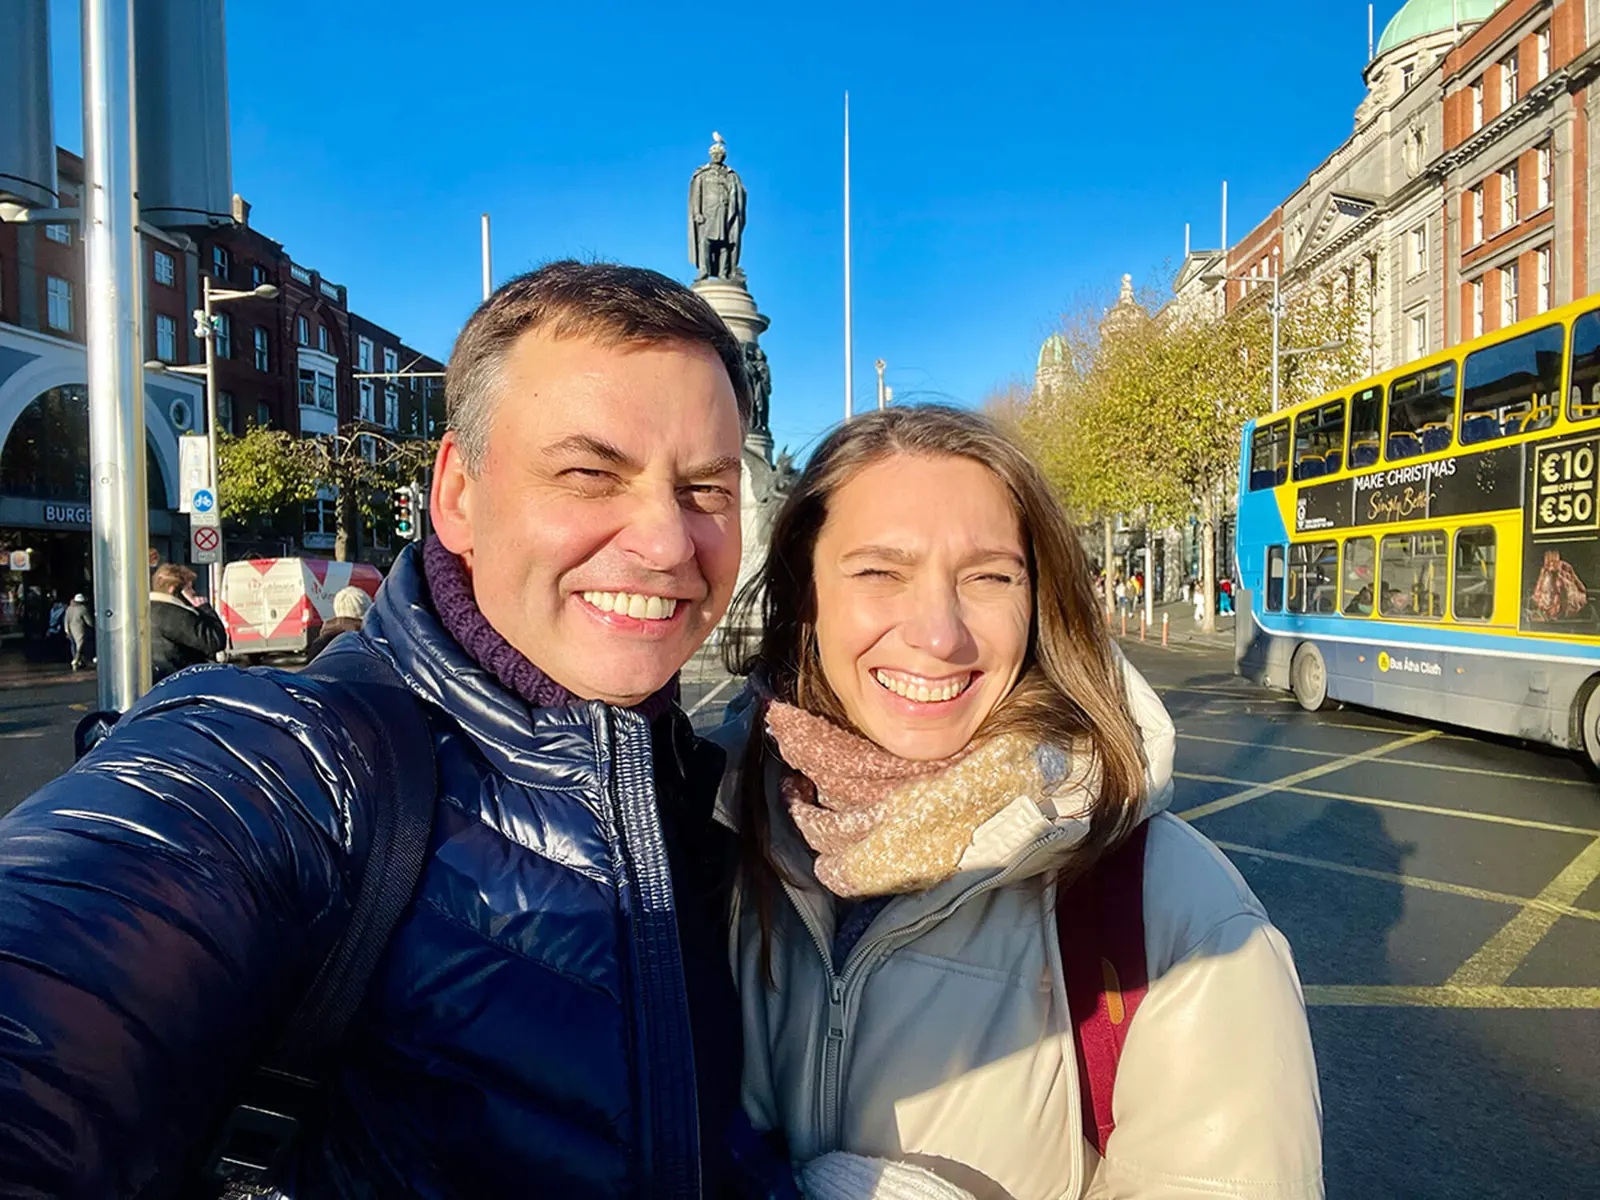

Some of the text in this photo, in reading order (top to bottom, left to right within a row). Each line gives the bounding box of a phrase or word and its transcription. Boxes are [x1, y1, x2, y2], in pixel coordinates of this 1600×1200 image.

[1354, 458, 1456, 491] MAKE CHRISTMAS
[1541, 447, 1594, 482] €10
[1368, 491, 1401, 522] Simply
[1539, 492, 1592, 523] €50
[1390, 657, 1403, 670] Bus
